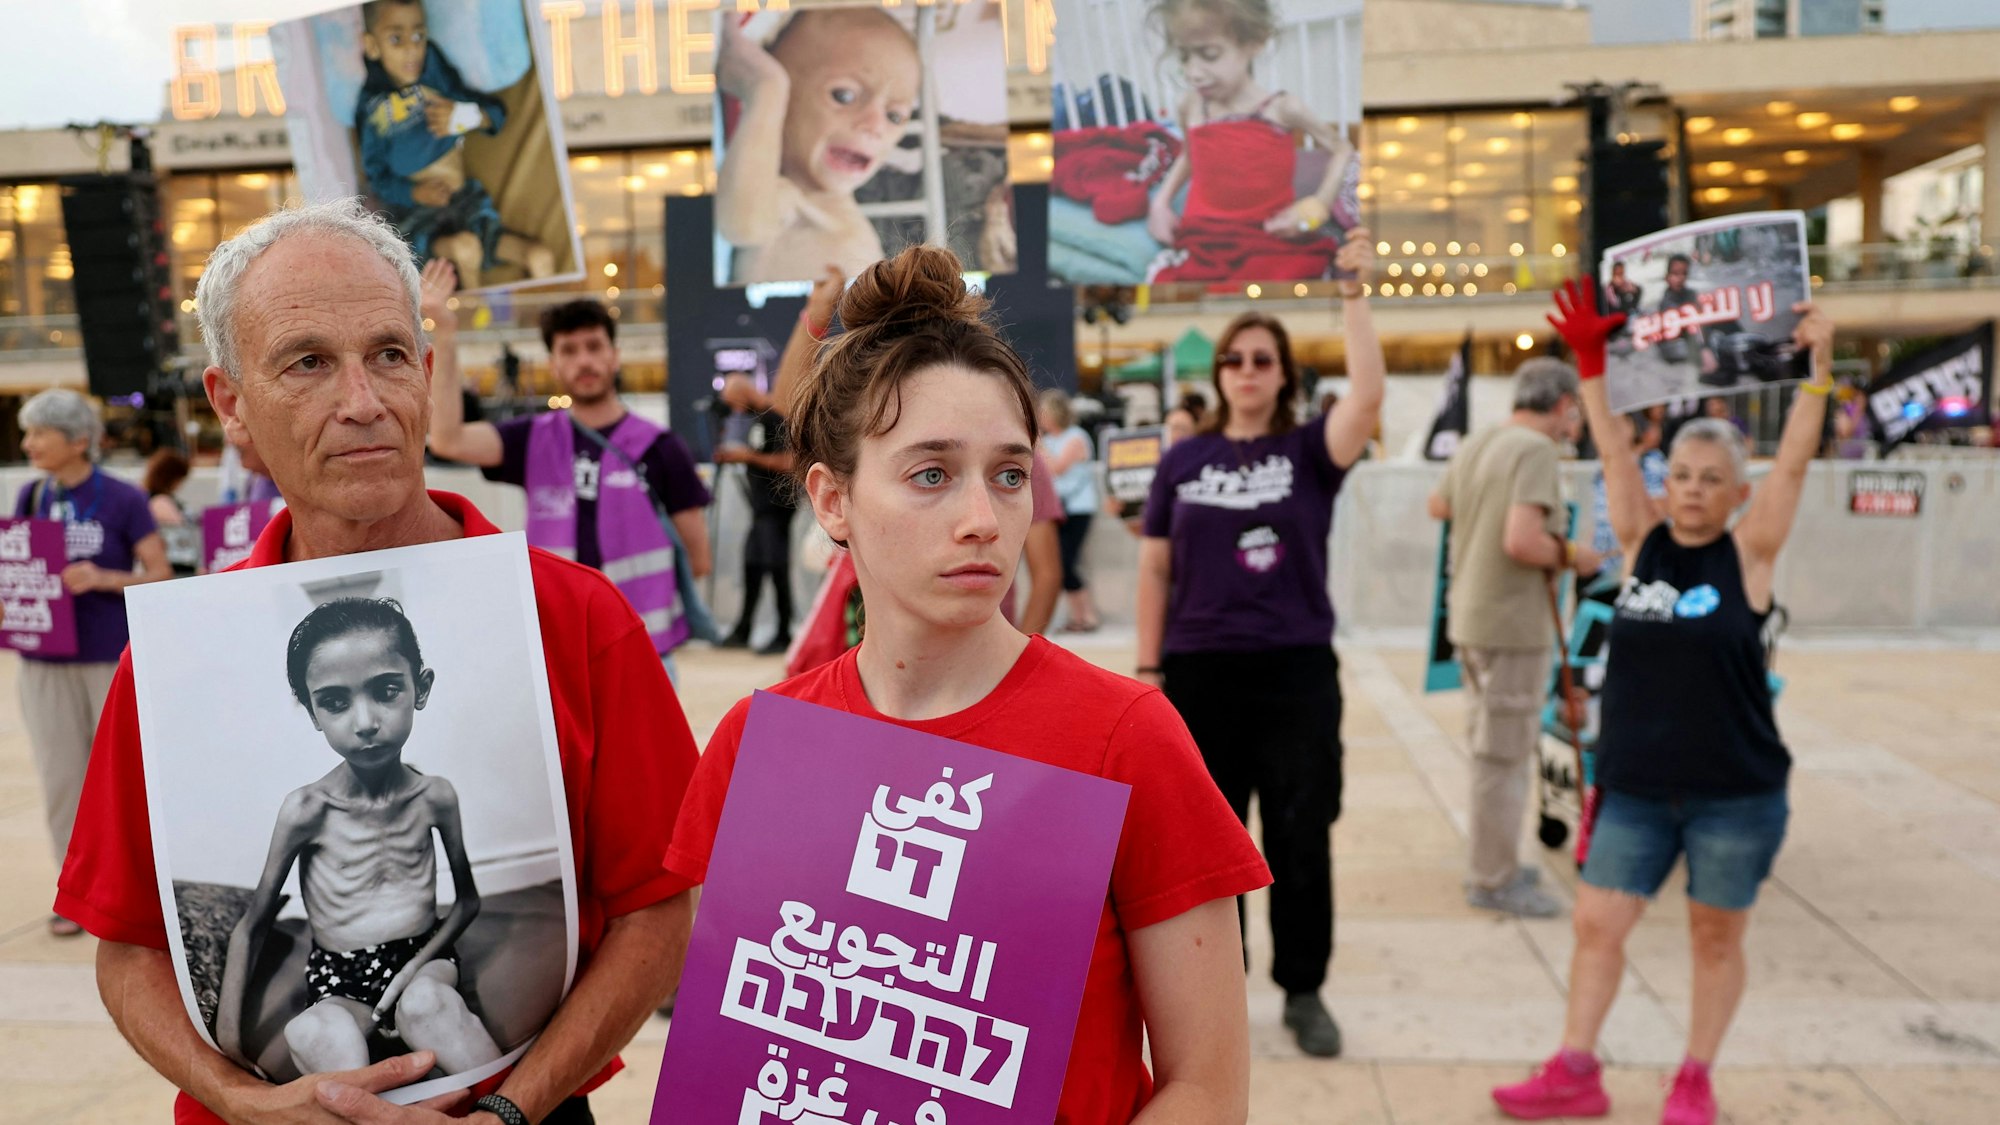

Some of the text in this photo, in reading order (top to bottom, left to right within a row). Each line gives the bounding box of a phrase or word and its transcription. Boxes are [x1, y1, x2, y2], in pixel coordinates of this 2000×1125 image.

[1631, 280, 1775, 351] لا للتجويع
[871, 766, 994, 831] كفى
[873, 832, 944, 899] די
[769, 900, 998, 1003] التجويع
[737, 957, 1014, 1087] להרעבה
[756, 1043, 849, 1121] غزة
